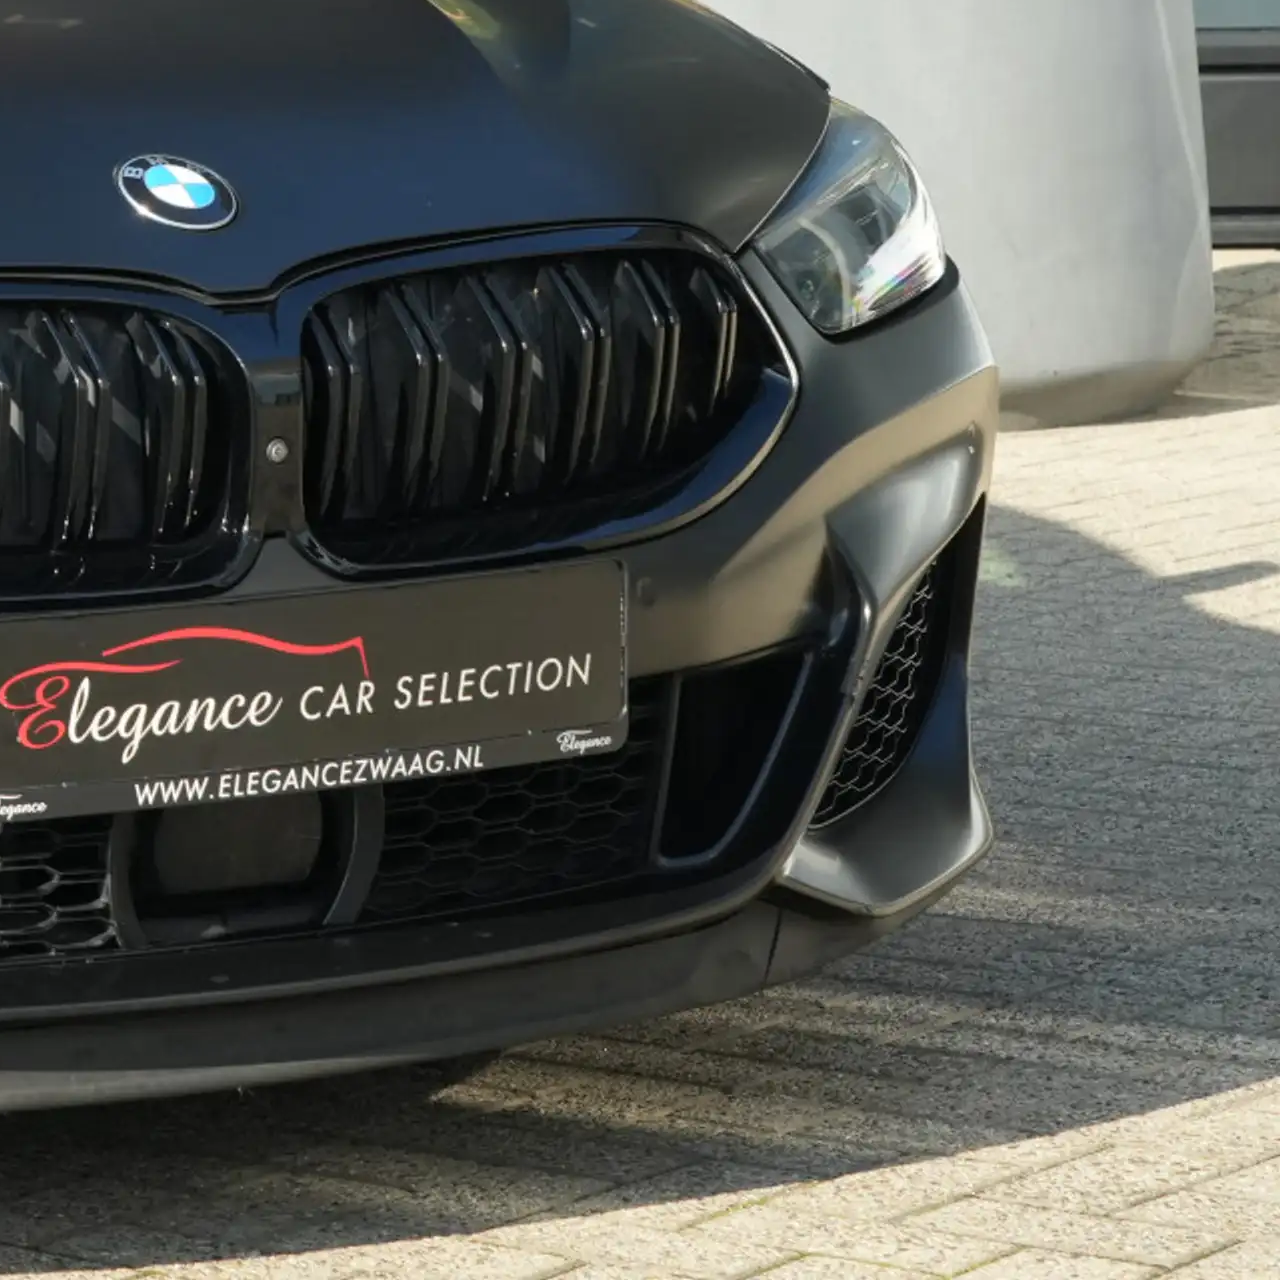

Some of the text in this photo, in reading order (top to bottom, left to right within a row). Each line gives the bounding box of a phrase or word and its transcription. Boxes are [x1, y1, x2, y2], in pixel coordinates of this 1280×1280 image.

[299, 680, 376, 721] CAR
[393, 653, 592, 710] SELECTION
[134, 745, 484, 806] WWW.ELEGANCEZWAAG.NL
